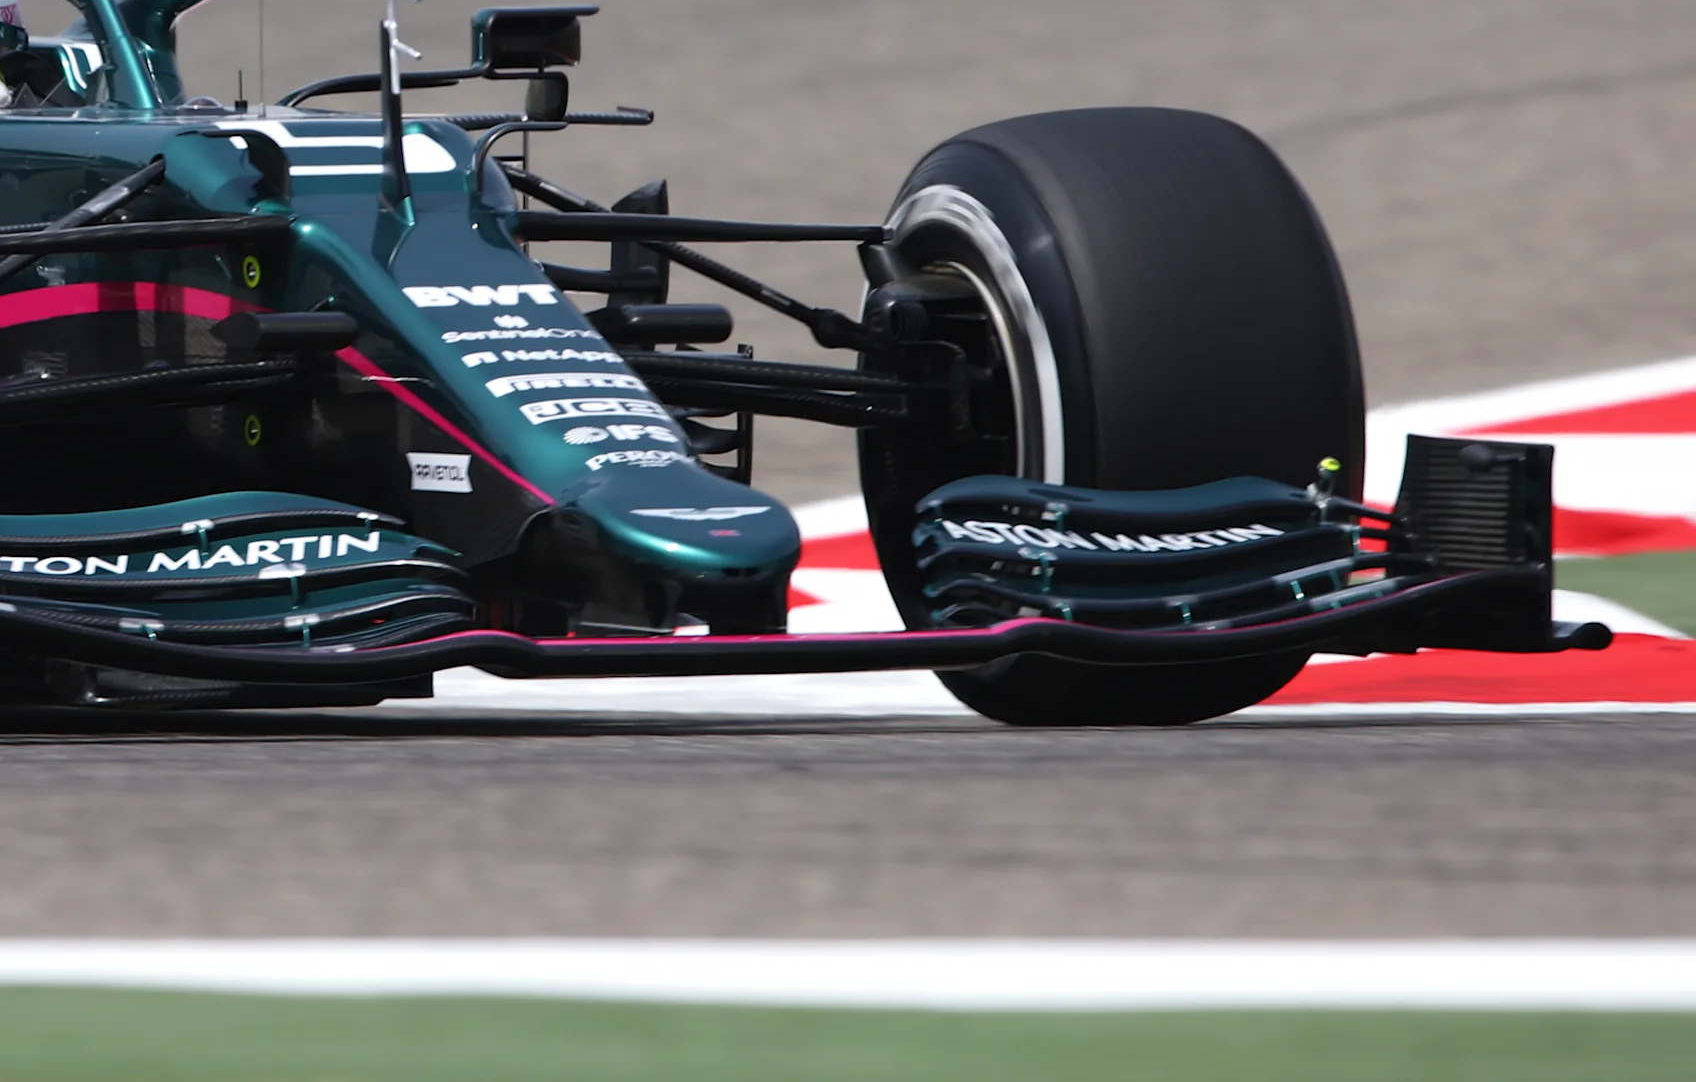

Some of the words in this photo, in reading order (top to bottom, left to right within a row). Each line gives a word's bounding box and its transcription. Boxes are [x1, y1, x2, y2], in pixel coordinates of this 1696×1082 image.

[402, 284, 558, 308] BWT
[606, 424, 679, 444] IFS
[942, 520, 1098, 551] ASTON
[1091, 523, 1285, 552] MARTIN
[147, 531, 381, 572] MARTIN
